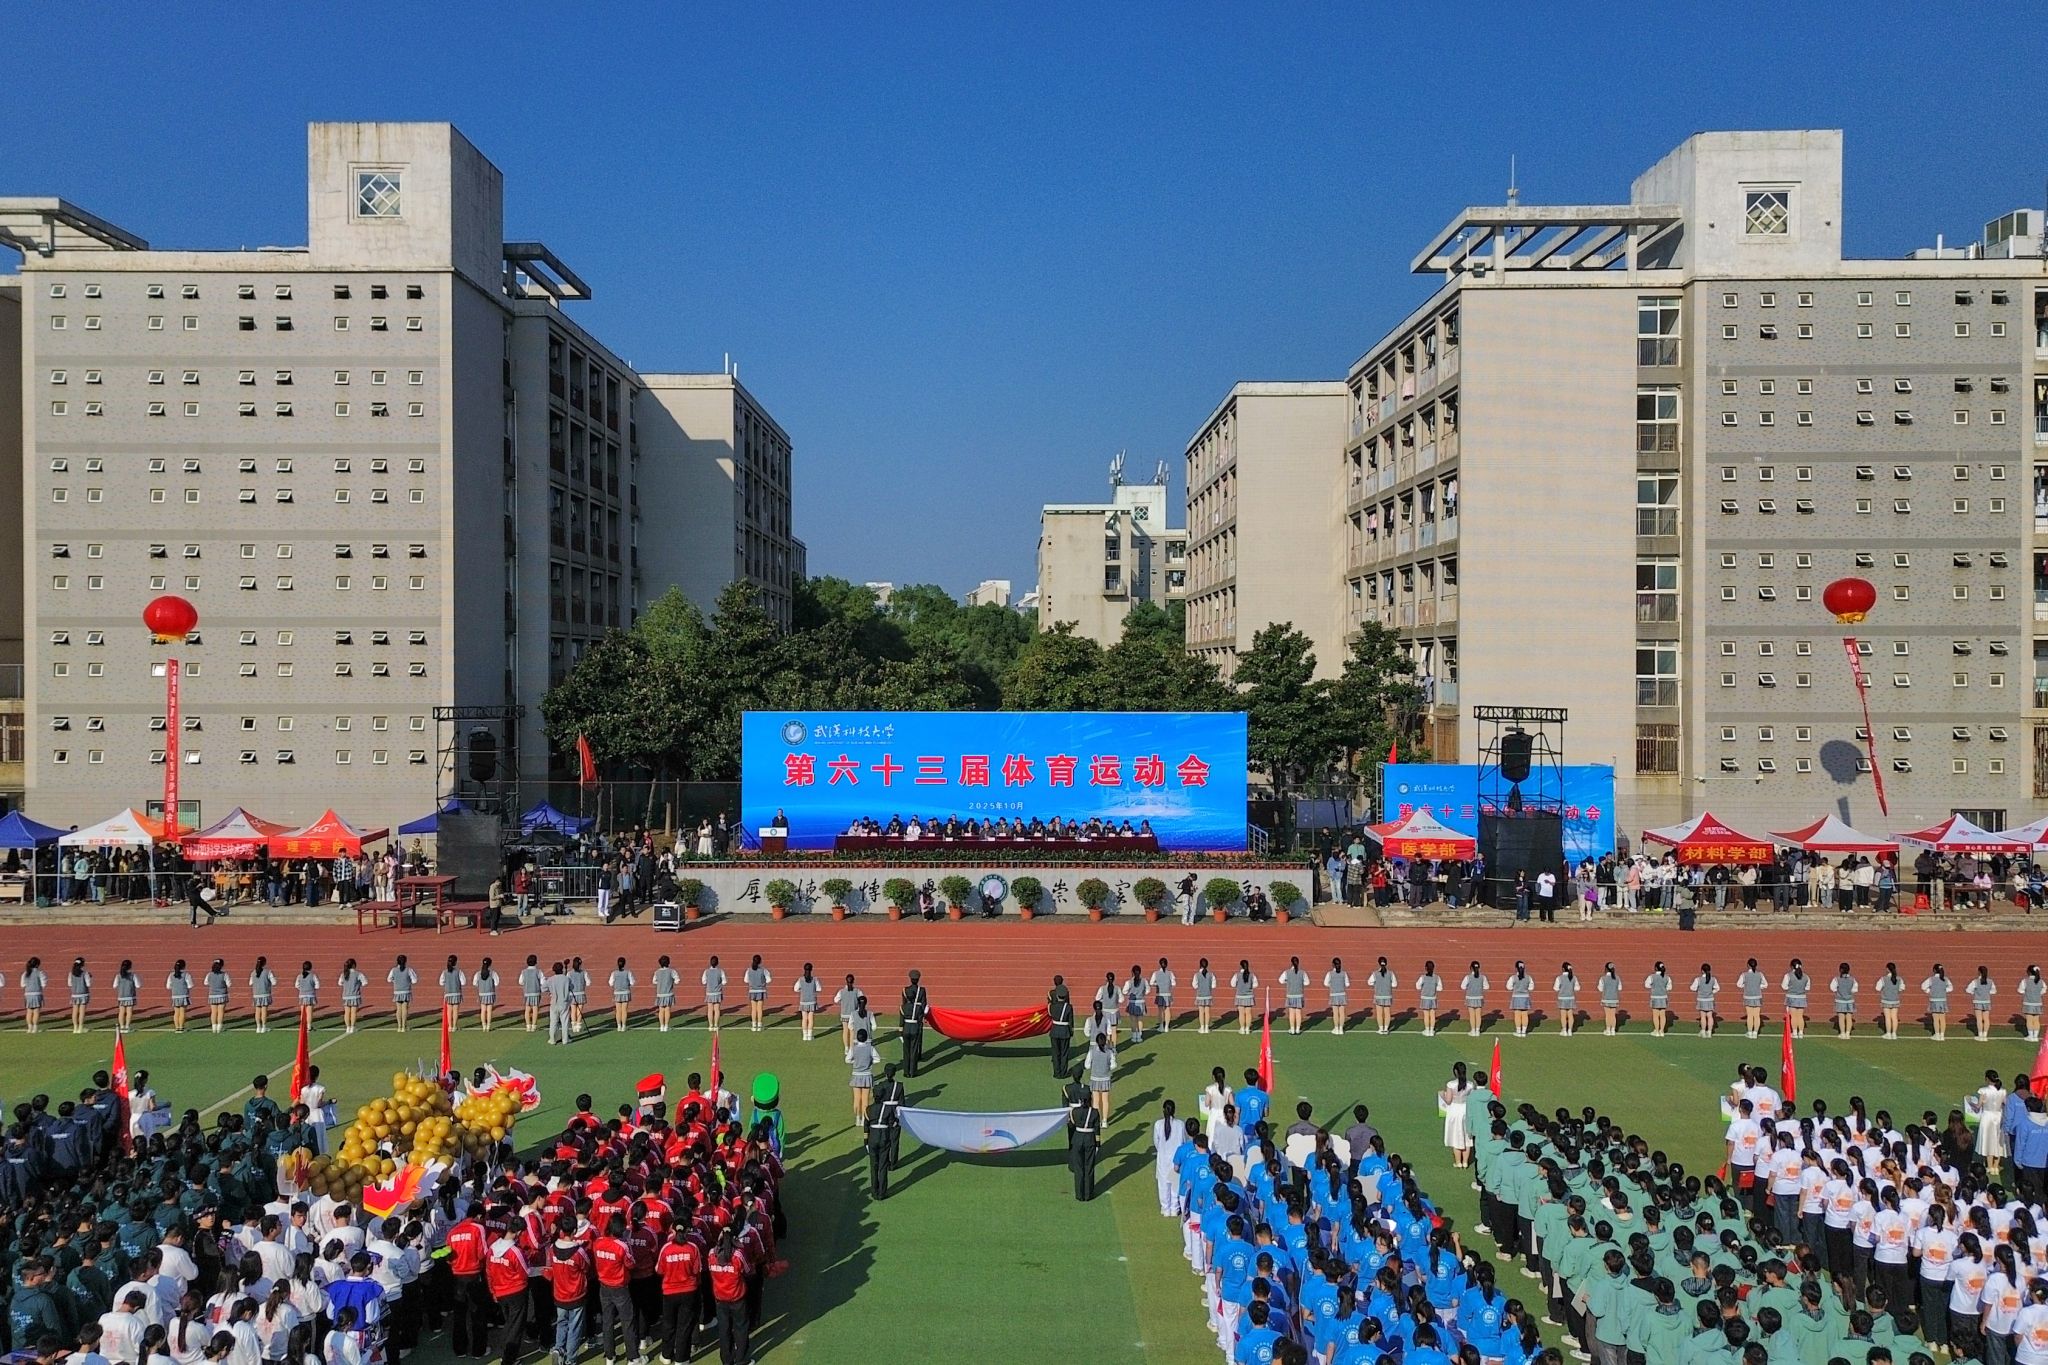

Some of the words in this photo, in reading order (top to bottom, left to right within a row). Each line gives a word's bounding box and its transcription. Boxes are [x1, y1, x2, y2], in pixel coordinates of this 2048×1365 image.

[783, 753, 1211, 787] 第六十三届体育运动会
[968, 801, 1024, 810] 2025年10月
[287, 840, 346, 854] 理学院
[1401, 842, 1456, 857] 医学部
[1685, 846, 1767, 860] 材料学部
[666, 1253, 691, 1263] 城建学院
